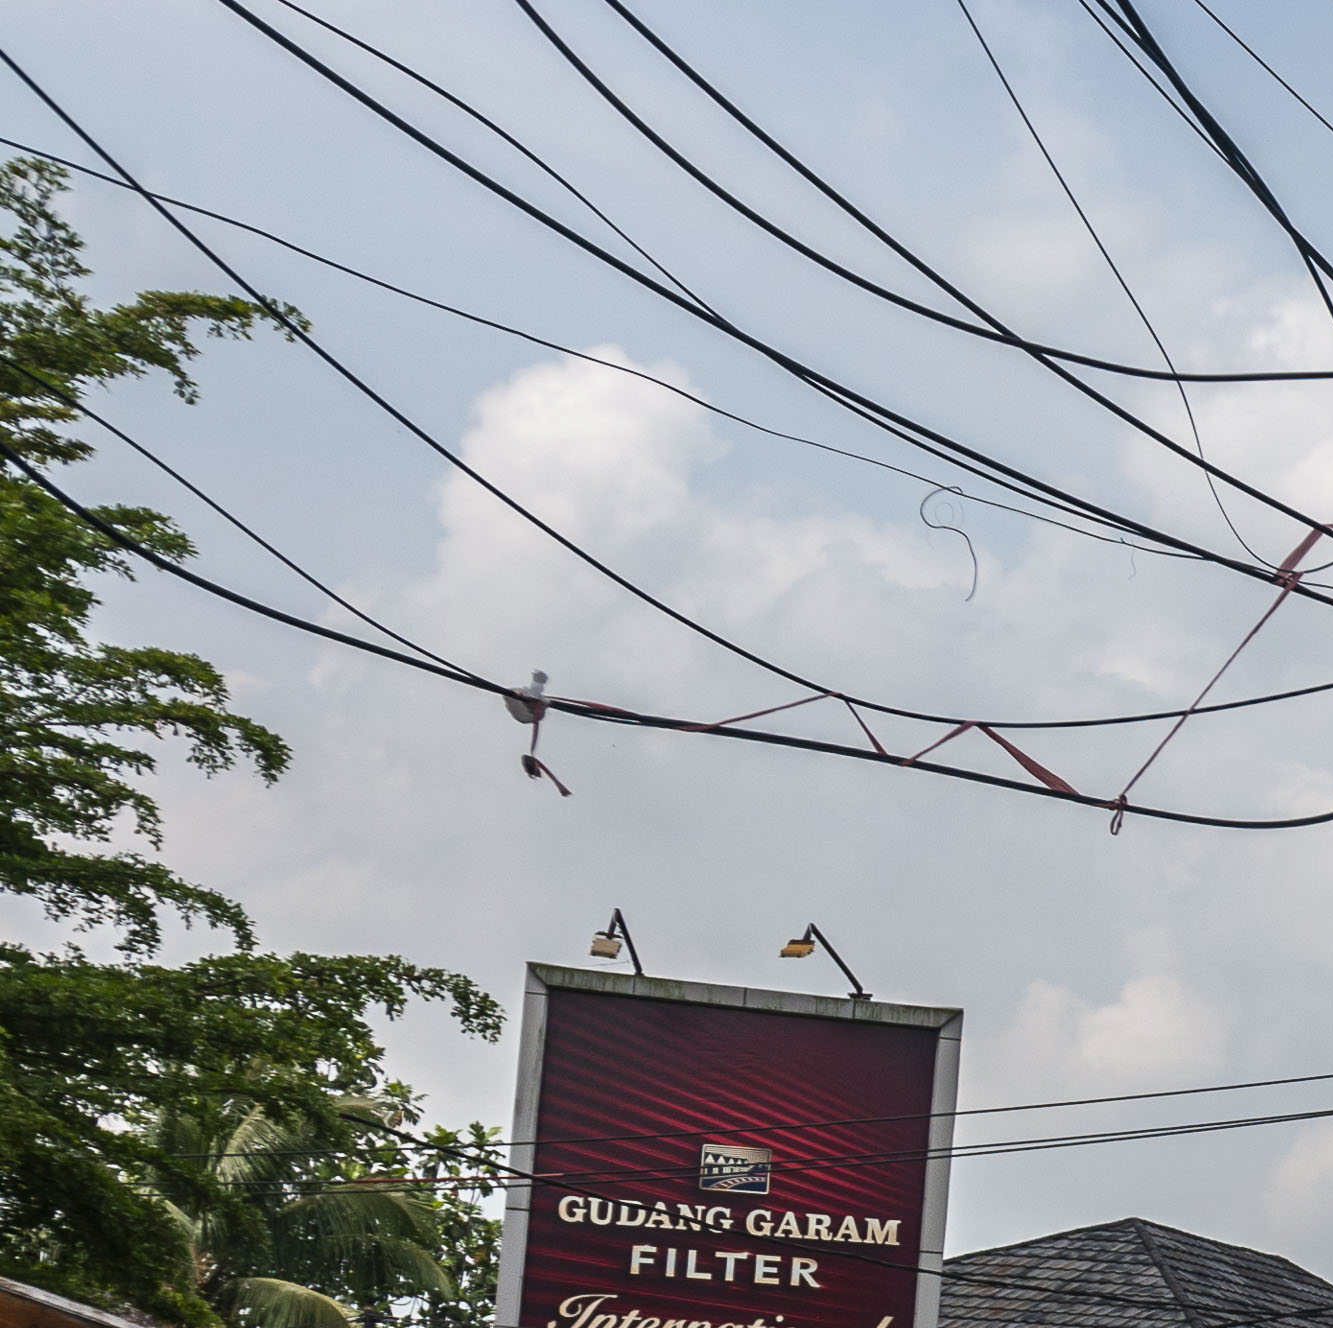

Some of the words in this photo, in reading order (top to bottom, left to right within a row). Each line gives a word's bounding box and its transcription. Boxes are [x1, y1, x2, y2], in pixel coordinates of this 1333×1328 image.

[558, 1195, 734, 1234] GUDANG
[745, 1208, 902, 1246] GARAM
[629, 1244, 821, 1288] FILTER
